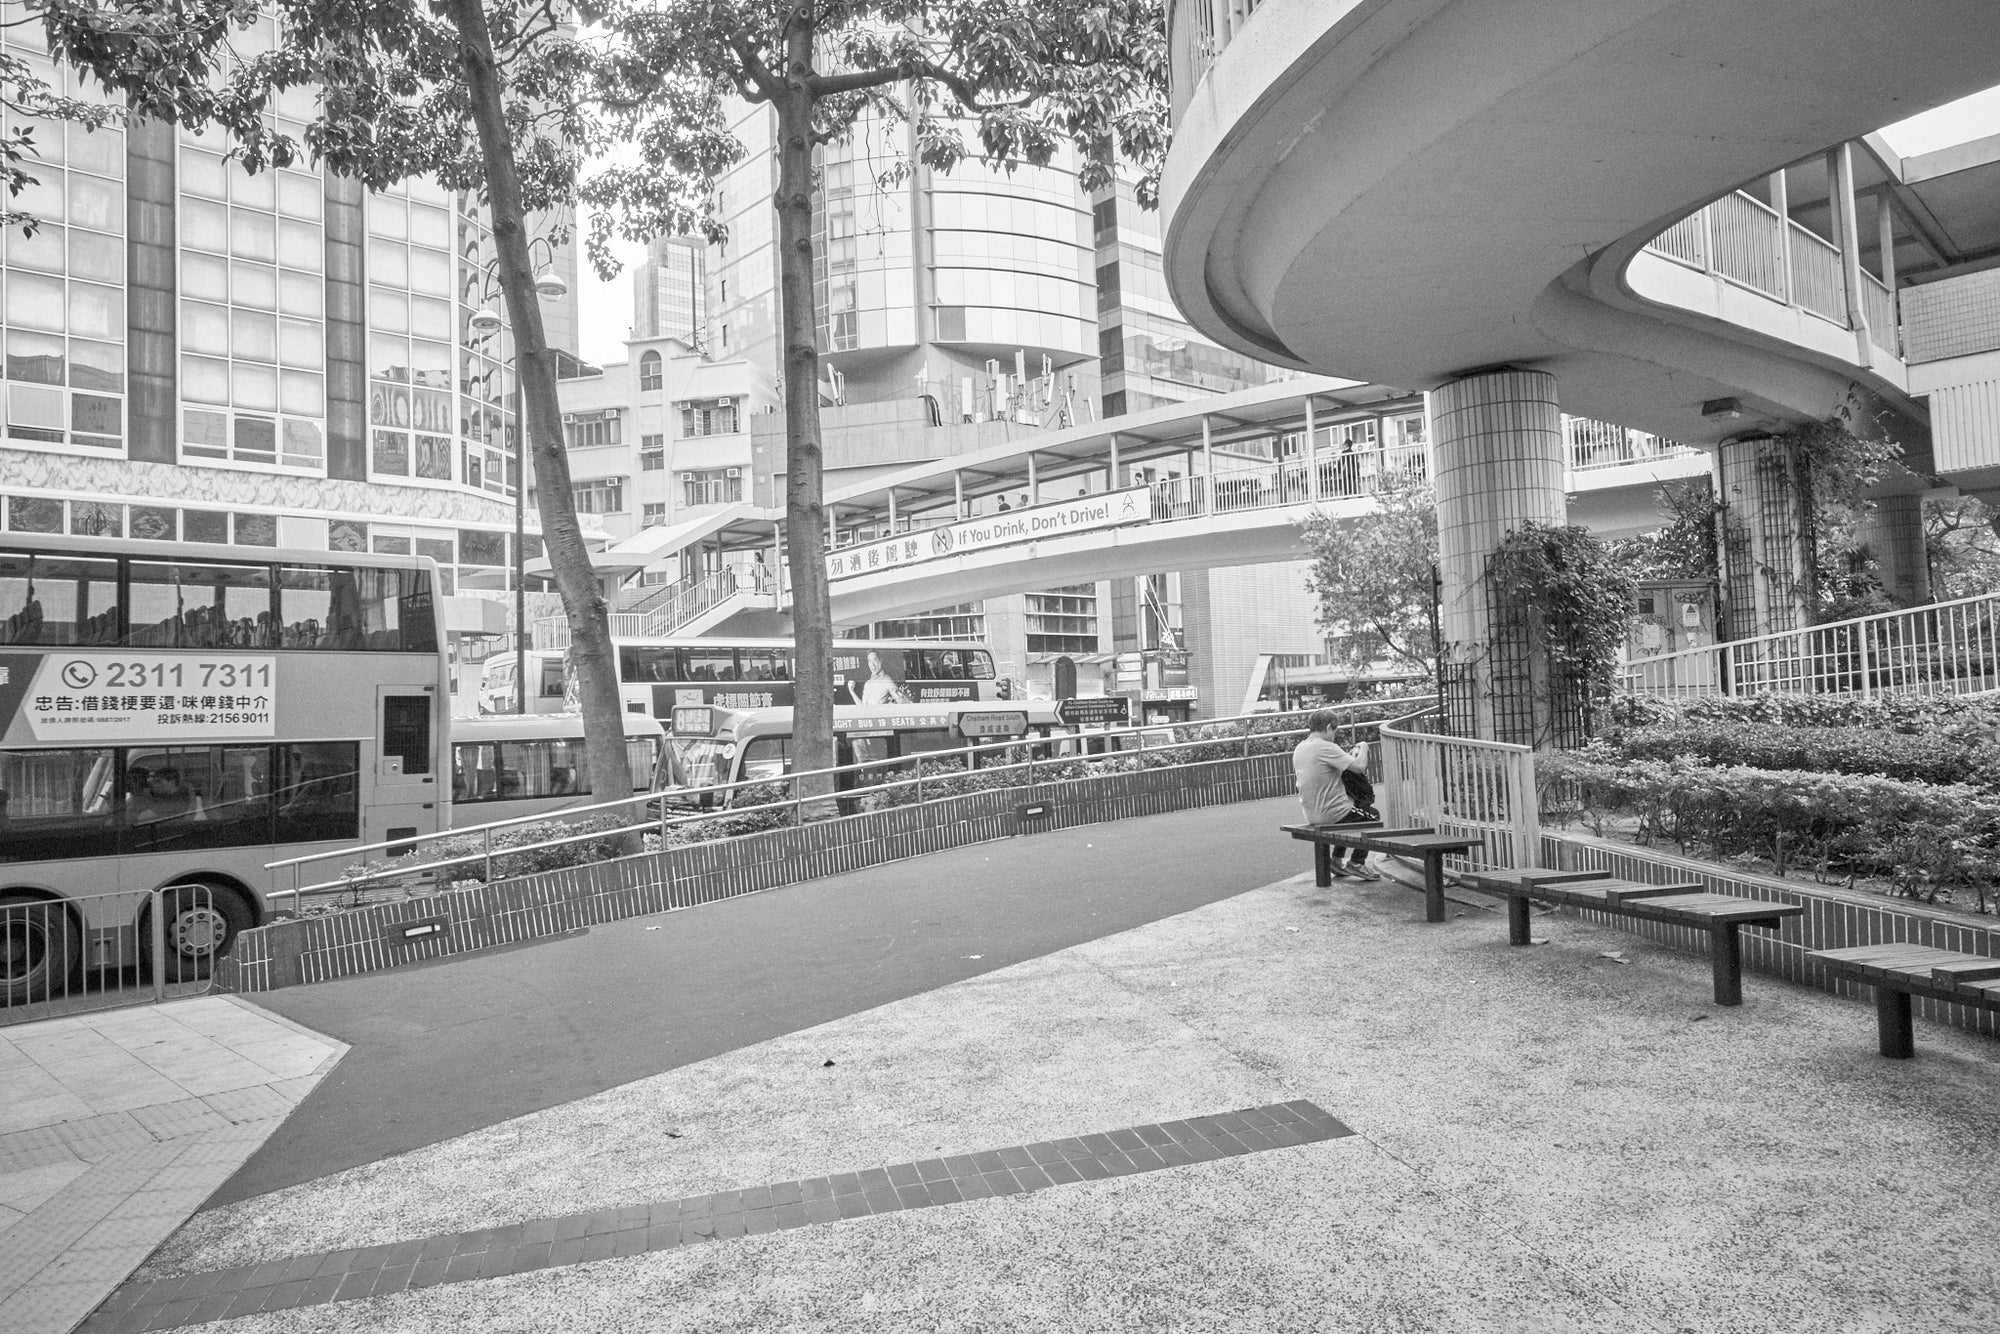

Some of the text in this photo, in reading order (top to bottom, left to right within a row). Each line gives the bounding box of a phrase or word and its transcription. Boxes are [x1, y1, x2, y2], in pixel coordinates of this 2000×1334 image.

[959, 502, 1109, 545] If You Drink, Don't Drive!
[830, 539, 918, 576] 勿酒後駕駛
[106, 662, 269, 688] 2311 7311
[858, 718, 873, 728] BUS
[878, 718, 886, 727] 19
[891, 716, 915, 726] SEATS
